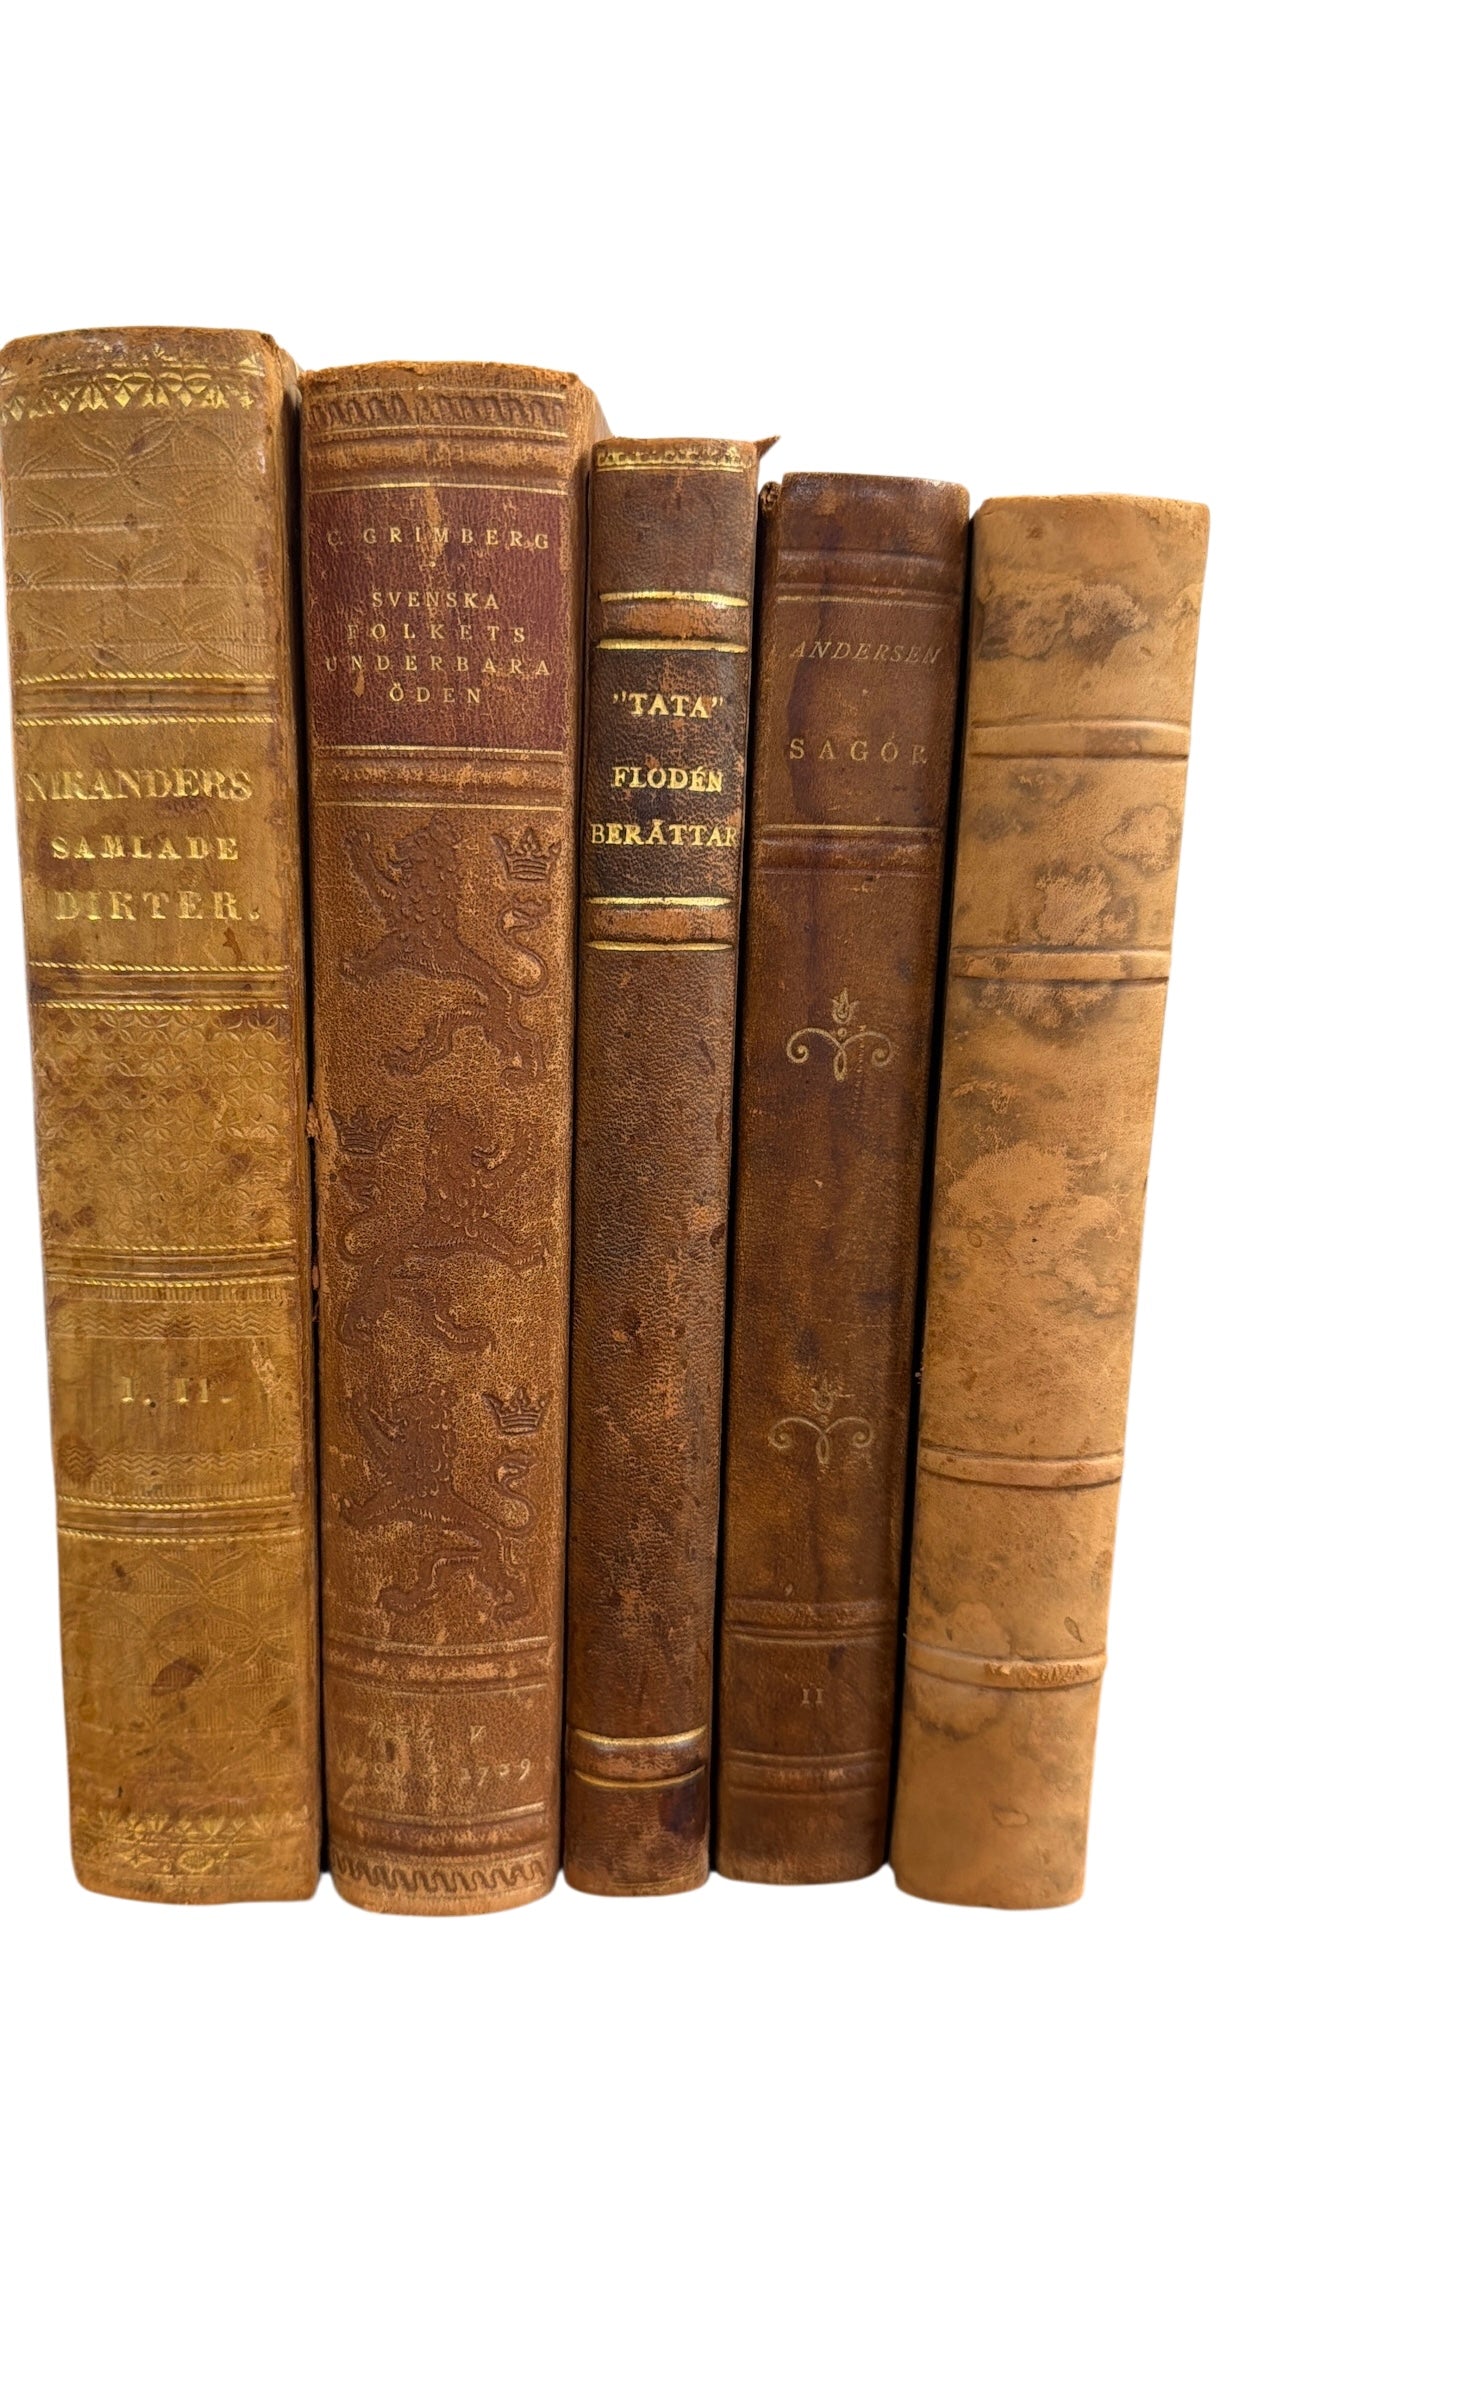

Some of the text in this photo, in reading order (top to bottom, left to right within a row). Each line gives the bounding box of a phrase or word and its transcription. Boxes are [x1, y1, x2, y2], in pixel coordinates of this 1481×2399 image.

[362, 526, 550, 550] GRIMBERG
[371, 591, 500, 610] SVENSKA
[347, 623, 526, 643] FOLKETS
[790, 640, 941, 665] ANDERSEN
[325, 655, 551, 676] UNDERBARA
[389, 682, 482, 704] ÖDEN
[611, 765, 723, 793] FLODÉN
[51, 834, 239, 860] SAMLADE
[54, 890, 260, 921] DIKTER.
